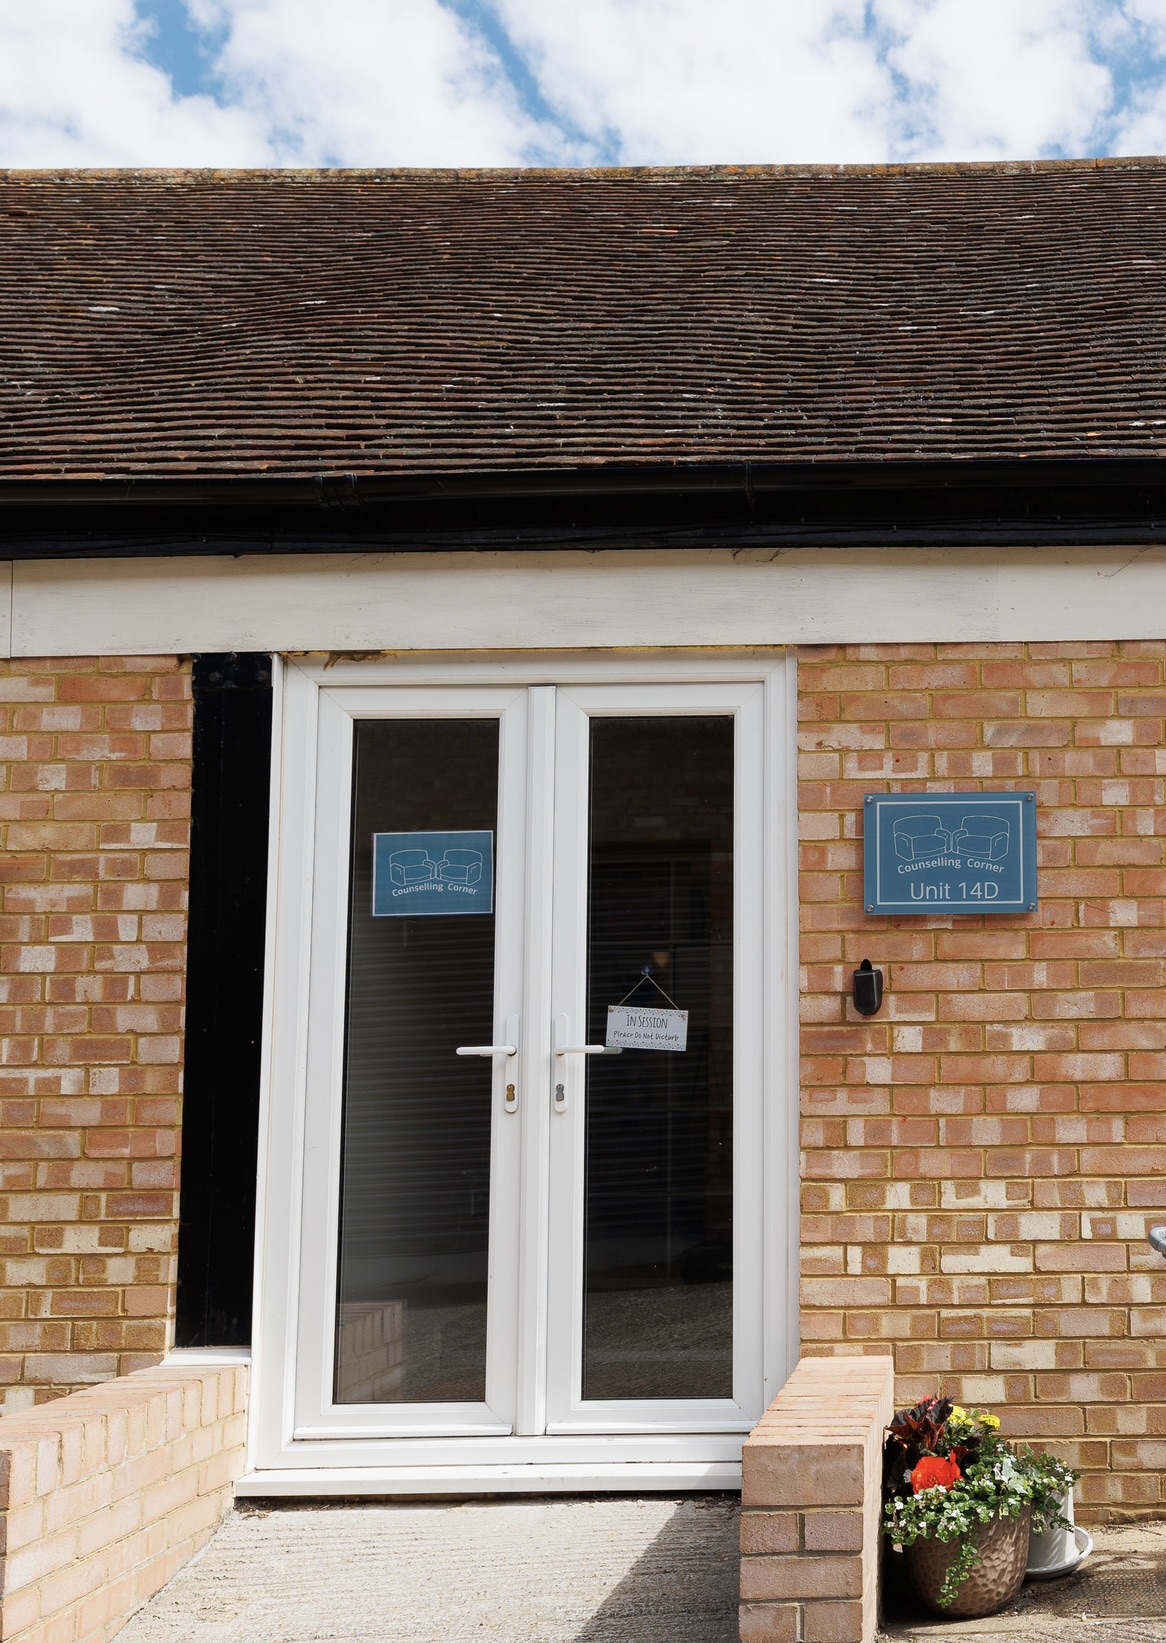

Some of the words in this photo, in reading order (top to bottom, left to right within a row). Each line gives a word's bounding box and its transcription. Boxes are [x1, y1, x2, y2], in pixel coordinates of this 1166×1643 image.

[897, 857, 961, 874] Counselling
[967, 858, 1005, 873] Corner
[392, 882, 443, 896] Counselling
[447, 883, 478, 895] Corner
[910, 882, 950, 900] Unit
[958, 881, 999, 899] 14D
[613, 1030, 634, 1038] Please
[635, 1031, 641, 1039] Do
[655, 1033, 679, 1041] Disturb
